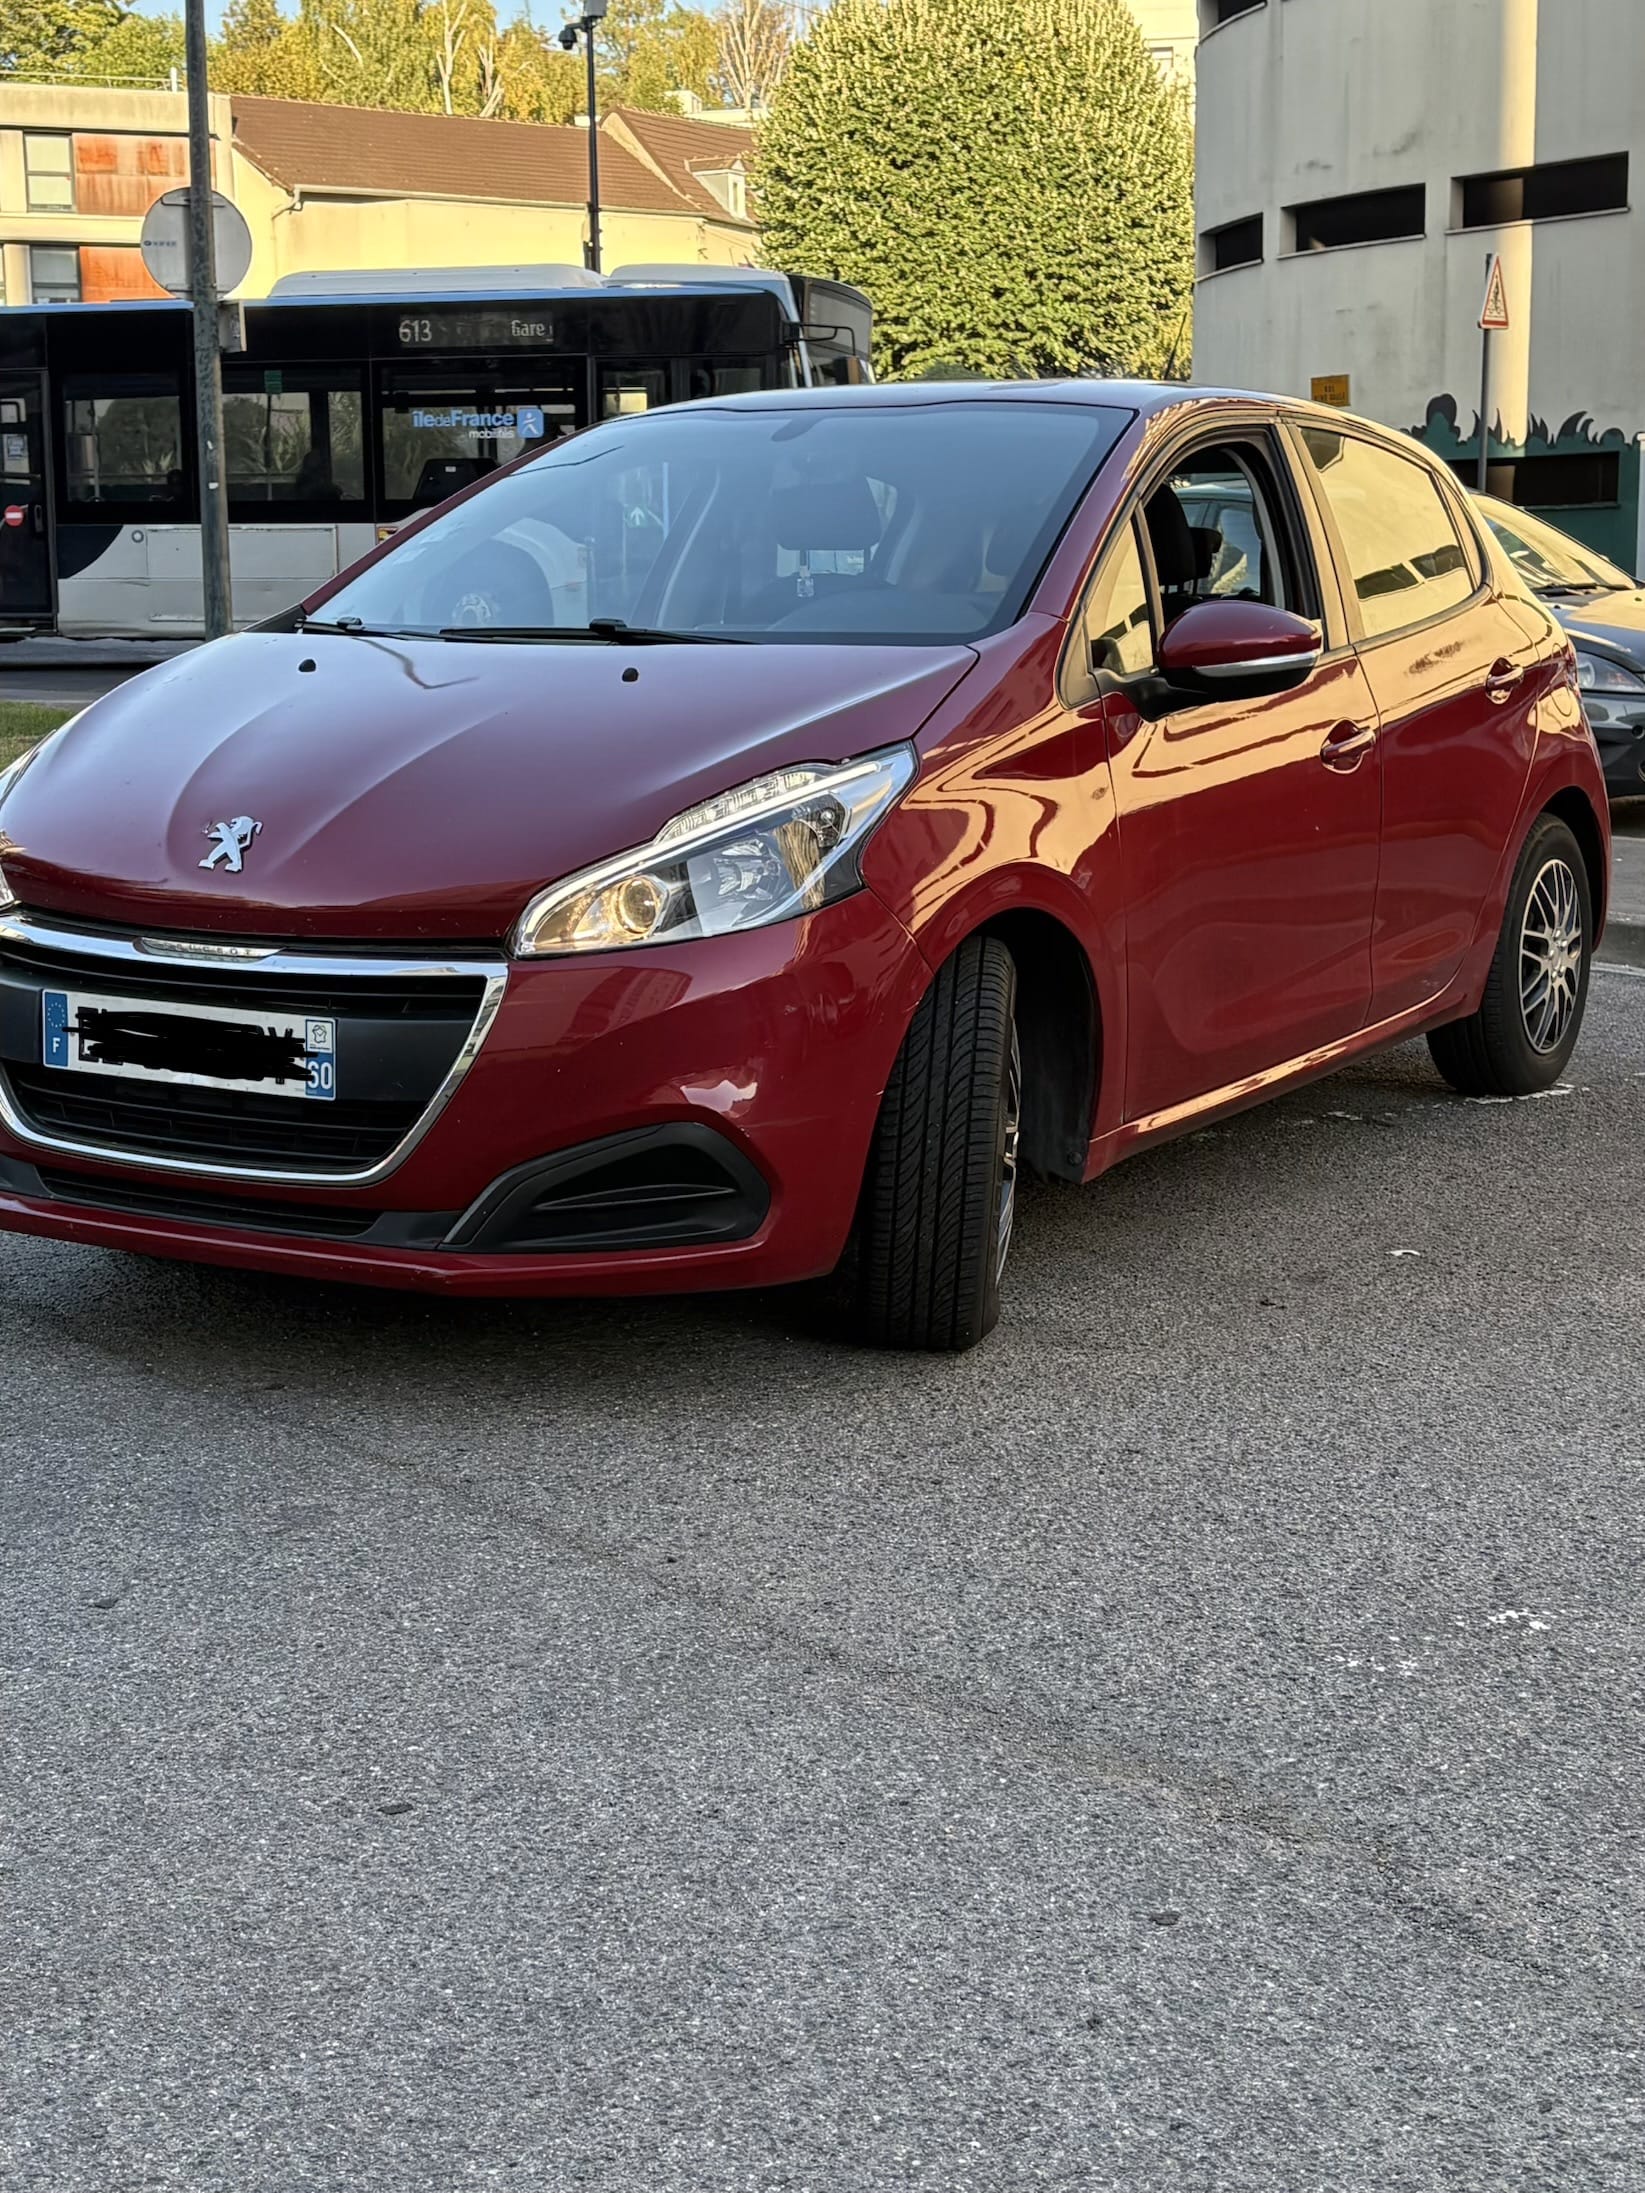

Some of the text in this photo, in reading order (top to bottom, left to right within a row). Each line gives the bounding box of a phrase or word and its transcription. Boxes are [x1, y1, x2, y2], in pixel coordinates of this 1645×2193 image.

[399, 319, 432, 342] 613
[511, 319, 546, 337] Gare
[52, 1037, 61, 1053] F
